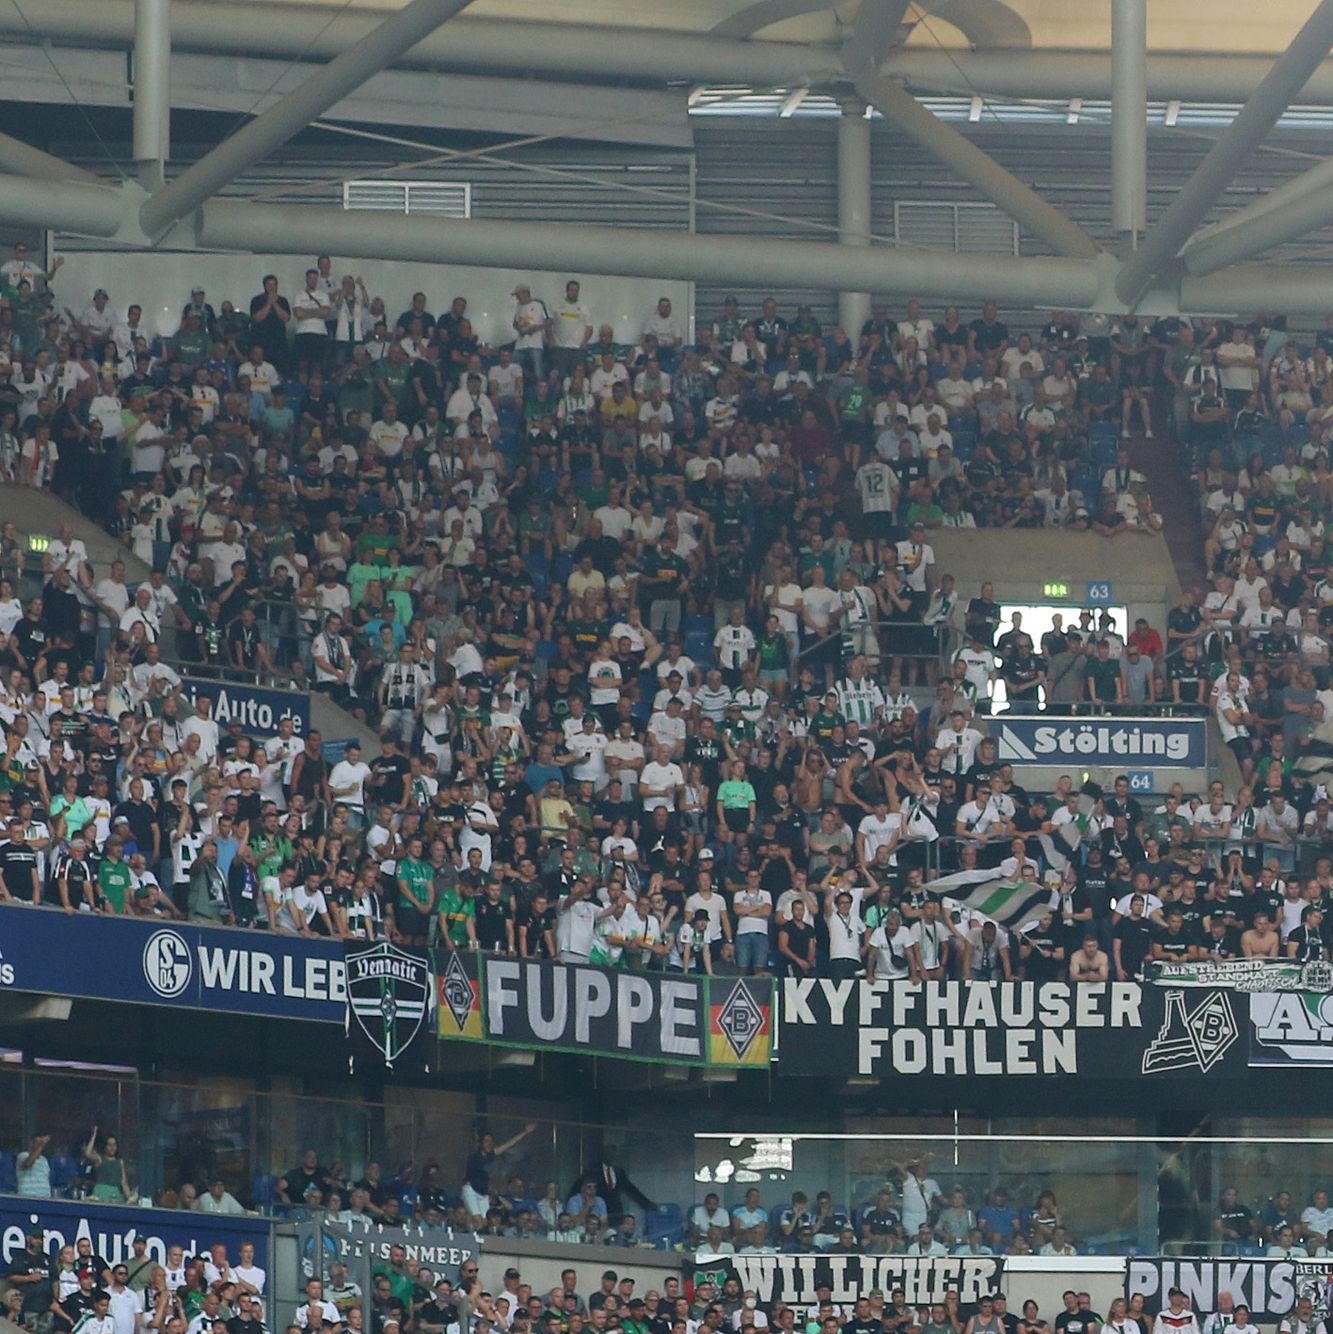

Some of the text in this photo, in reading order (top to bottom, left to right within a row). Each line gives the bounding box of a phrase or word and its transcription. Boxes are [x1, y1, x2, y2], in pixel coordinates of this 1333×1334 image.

[1090, 584, 1109, 599] 63
[1034, 722, 1189, 761] Stölting
[1131, 775, 1150, 789] 64
[198, 946, 347, 1001] WIR LEB
[486, 959, 700, 1056] FUPPE
[784, 978, 1143, 1028] KYFFHÄUSER
[858, 1028, 1078, 1075] FOHLEN
[732, 1257, 999, 1303] WILLICHER
[1130, 1262, 1296, 1315] PINKIS
